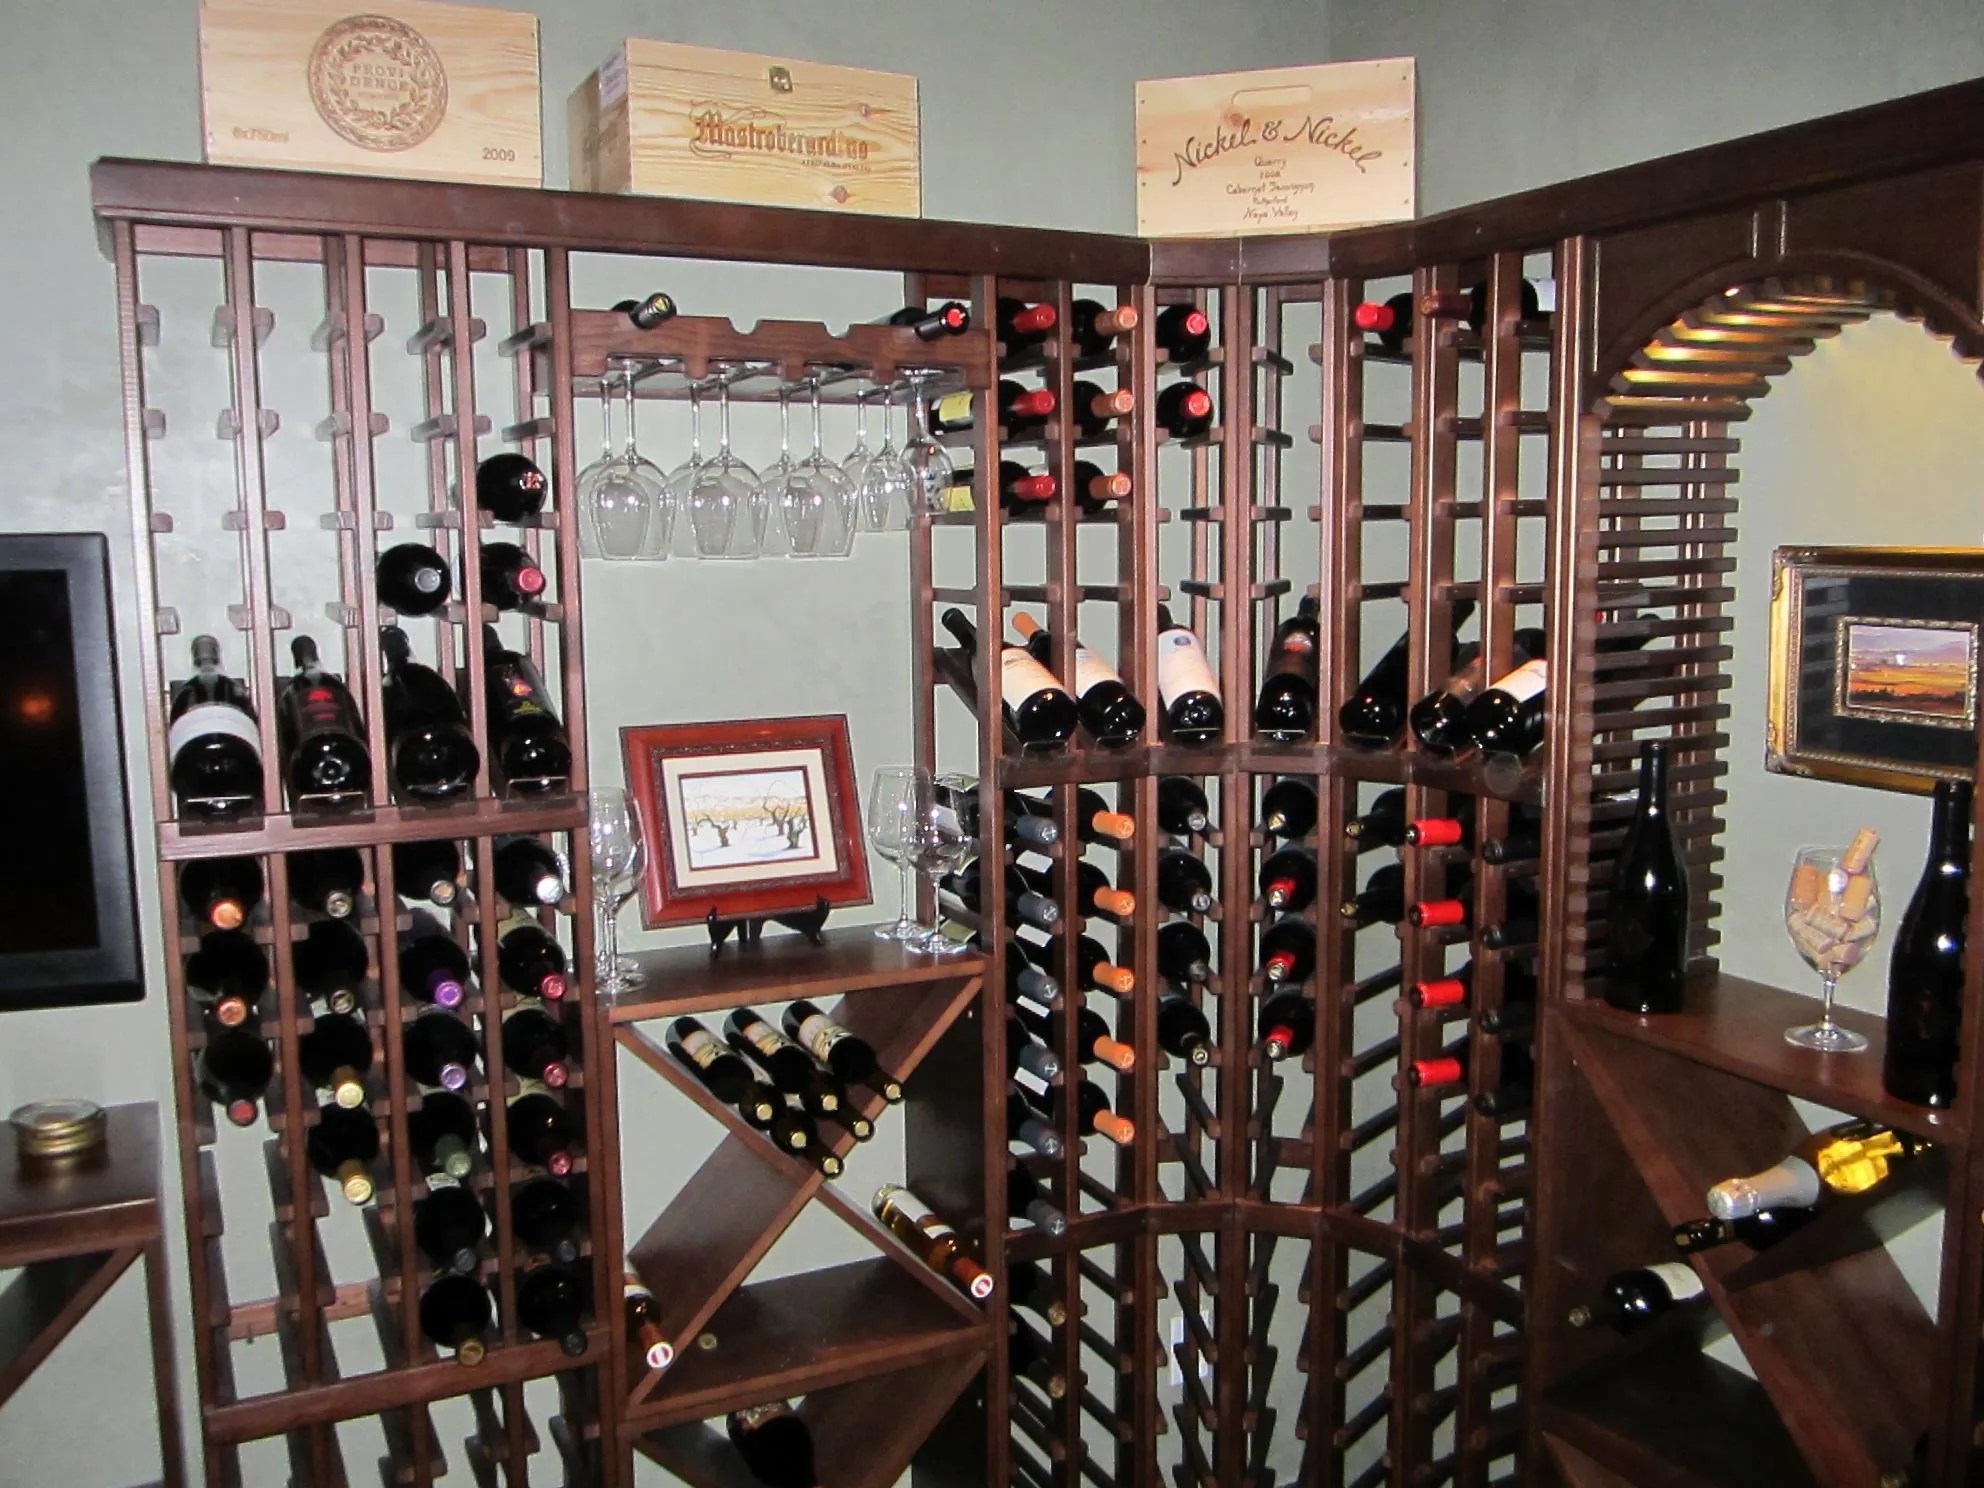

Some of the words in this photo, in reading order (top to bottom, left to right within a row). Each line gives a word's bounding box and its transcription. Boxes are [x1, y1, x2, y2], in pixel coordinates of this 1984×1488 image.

[482, 147, 516, 162] 2009
[1172, 118, 1257, 186] Nickel
[1261, 120, 1282, 141] &
[1283, 115, 1383, 174] Nickel
